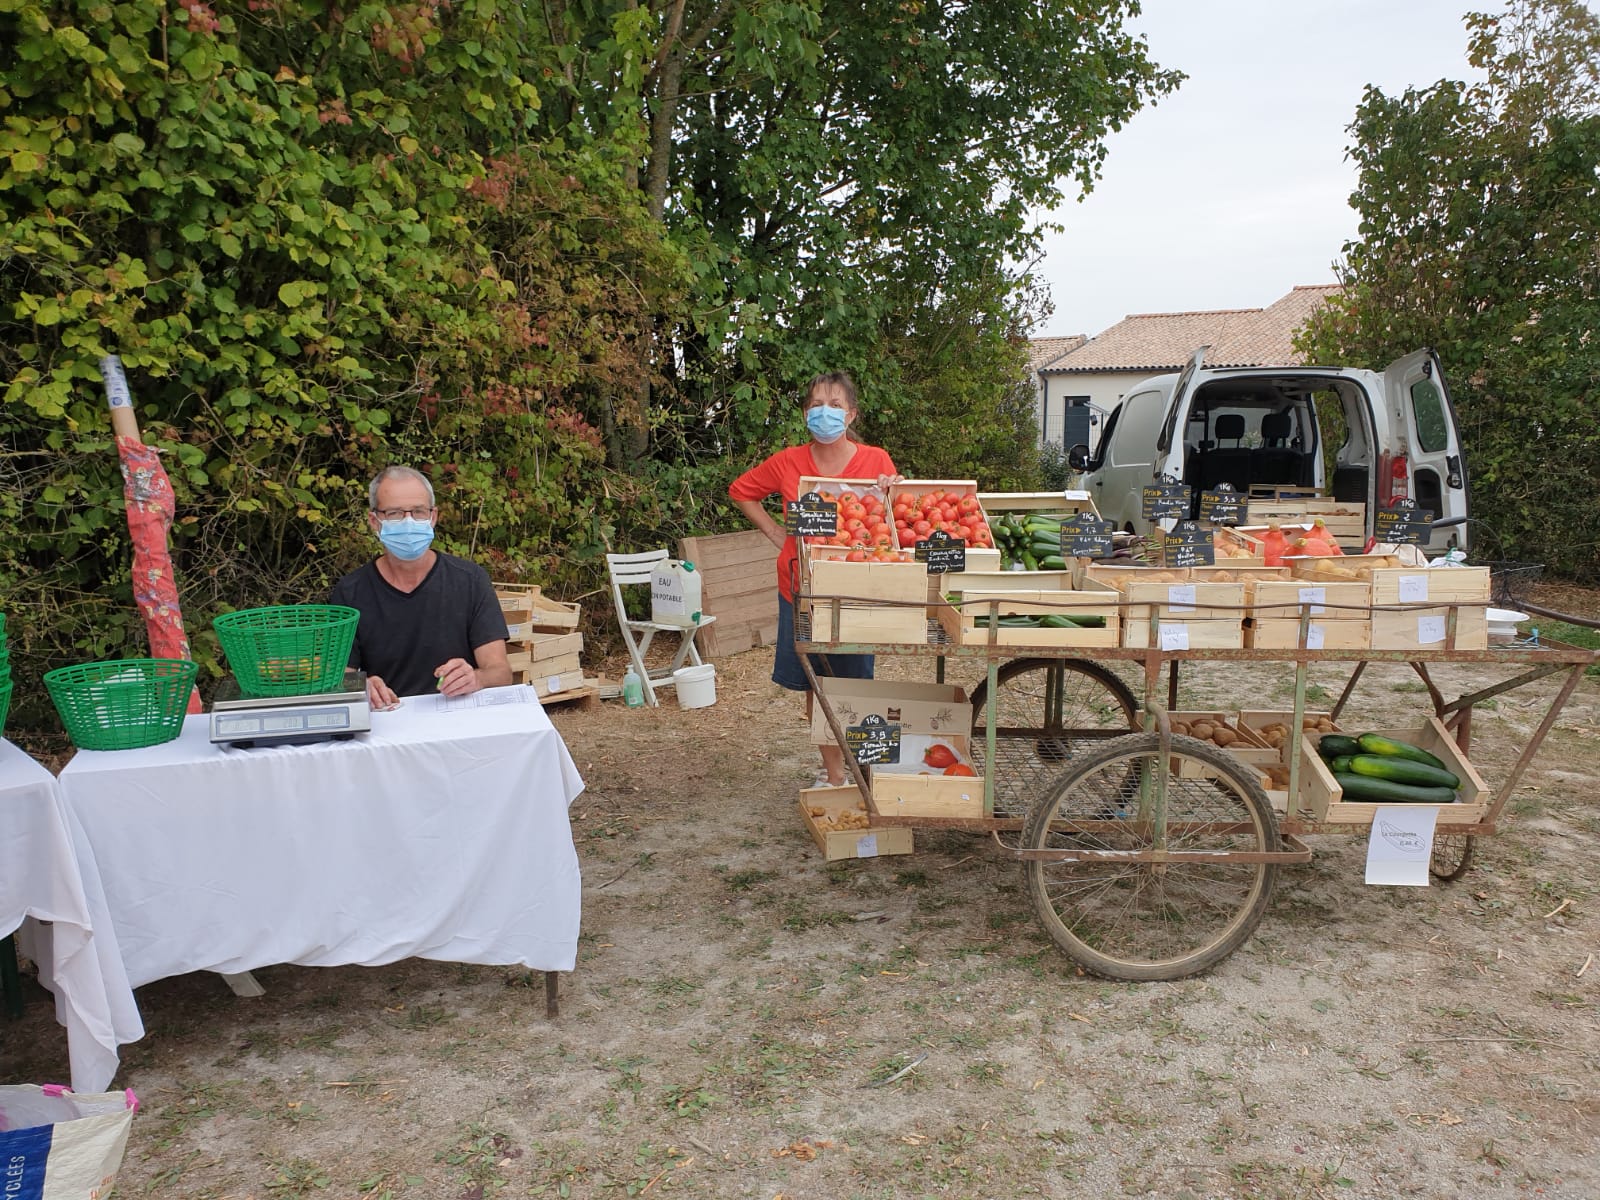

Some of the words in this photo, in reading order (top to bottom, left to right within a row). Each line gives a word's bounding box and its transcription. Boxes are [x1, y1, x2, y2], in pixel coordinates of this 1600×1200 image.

[1144, 489, 1157, 497] Prix
[1202, 494, 1215, 502] Prix
[1082, 512, 1095, 521] 1Kg
[1378, 511, 1392, 520] Prix
[1183, 521, 1195, 530] 1Kg
[1061, 526, 1075, 535] Prix
[1165, 536, 1178, 545] Prix
[1187, 535, 1195, 543] 2
[659, 578, 671, 586] EAU
[659, 593, 682, 603] POTABLE
[847, 731, 862, 739] Prix
